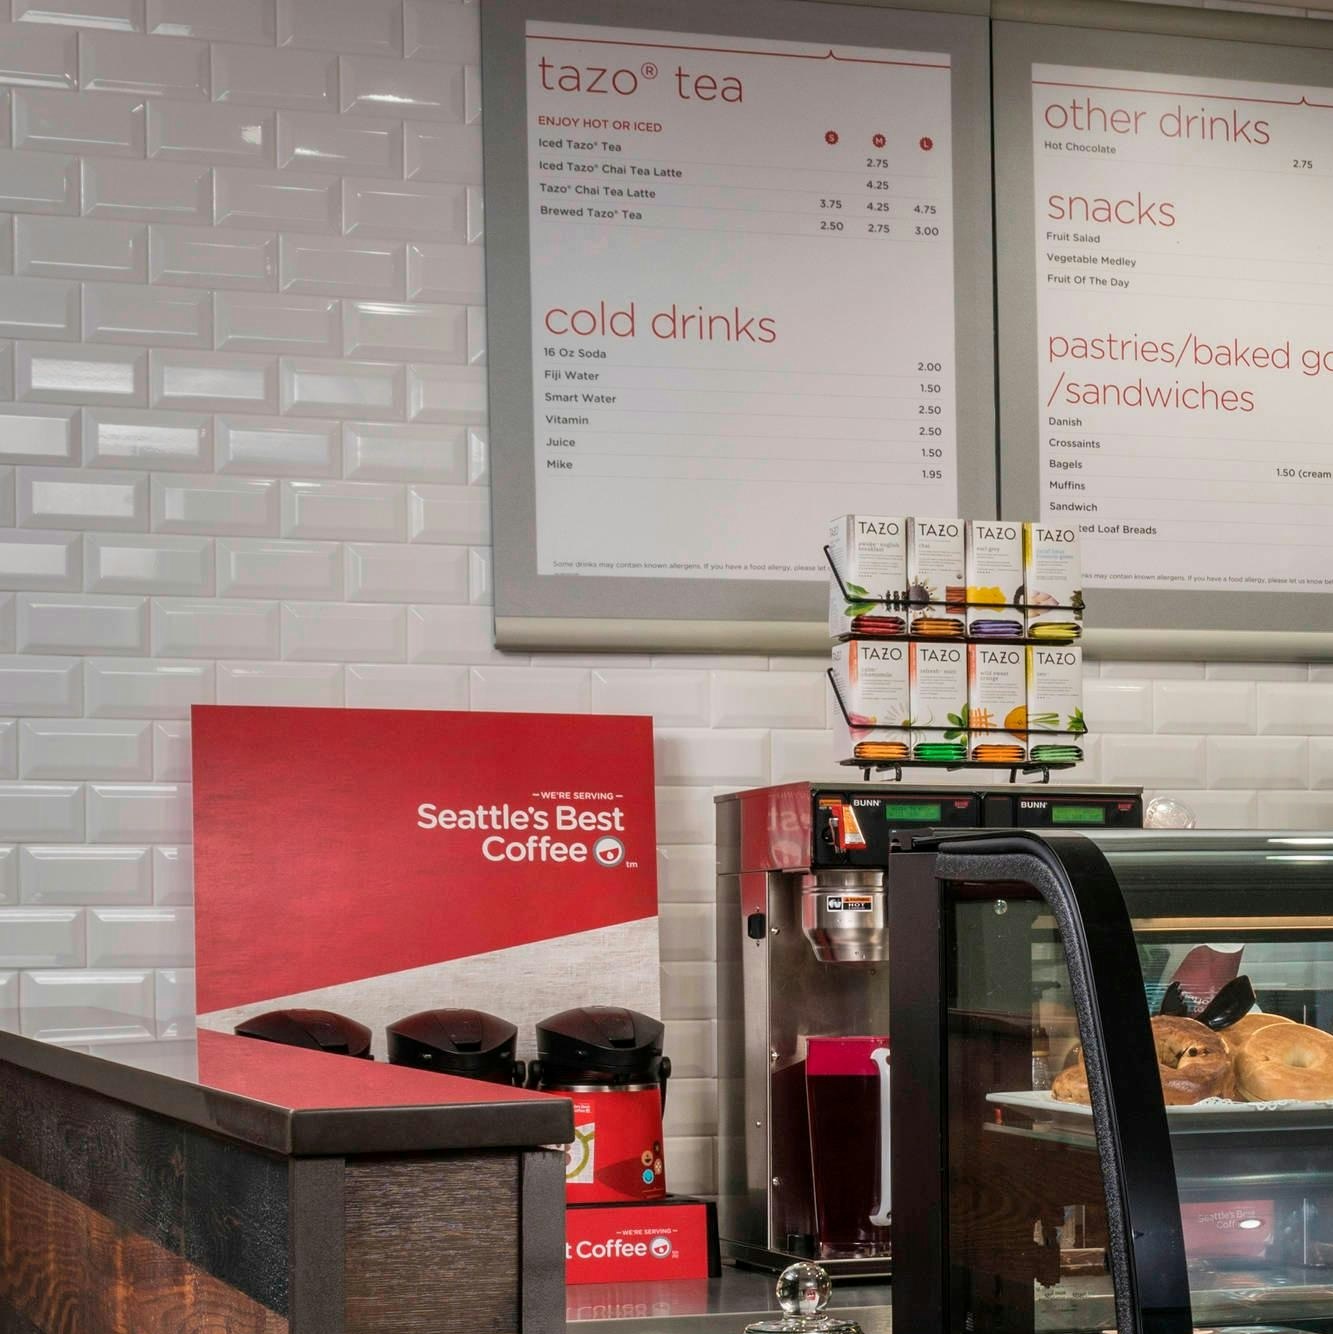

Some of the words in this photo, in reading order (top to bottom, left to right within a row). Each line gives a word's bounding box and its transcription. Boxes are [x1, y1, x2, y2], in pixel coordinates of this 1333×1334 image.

[675, 66, 742, 102] tea
[537, 115, 581, 128] ENJOY
[582, 118, 610, 129] HOT
[611, 119, 631, 131] OR
[633, 121, 663, 133] ICED
[1045, 97, 1146, 134] other
[1160, 105, 1270, 144] drinks
[538, 137, 564, 149] Iced
[600, 141, 622, 153] Tea
[1043, 140, 1063, 151] Hot
[1065, 141, 1117, 155] Chocolate
[539, 160, 564, 171] Iced
[601, 163, 627, 175] Chai
[629, 165, 651, 177] Tea
[653, 167, 683, 178] Latte
[866, 157, 889, 169] 2.75
[1292, 159, 1313, 170] 2.75
[574, 184, 600, 196] Chai
[602, 186, 624, 197] Tea
[626, 187, 657, 199] Latte
[865, 179, 889, 191] 4.25
[540, 204, 584, 217] Brewed
[621, 209, 643, 221] Tea
[819, 198, 843, 210] 3.75
[866, 201, 890, 212] 4.25
[913, 204, 937, 215] 4.75
[1048, 192, 1175, 227] snacks
[820, 220, 845, 232] 2.50
[867, 223, 891, 234] 2.75
[914, 225, 940, 237] 3.00
[1046, 231, 1071, 242] Fruit
[1072, 233, 1101, 244] Salad
[1046, 252, 1098, 265] Vegetable
[1100, 255, 1137, 268] Medley
[1047, 273, 1071, 284] Fruit
[1073, 275, 1087, 285] Of
[1088, 276, 1108, 287] The
[1110, 277, 1130, 289] Day
[545, 301, 634, 337] cold
[652, 304, 776, 343] drinks
[543, 347, 556, 357] 16
[558, 347, 575, 358] Oz
[577, 348, 607, 359] Soda
[1050, 333, 1289, 369] pastries/baked
[917, 361, 942, 373] 2.00
[544, 369, 562, 382] Fiji
[564, 370, 600, 381] Water
[920, 383, 942, 394] 1.50
[1047, 372, 1254, 412] /sandwiches
[544, 391, 579, 403] Smart
[581, 393, 617, 404] Water
[918, 404, 942, 415] 2.50
[545, 415, 589, 425] Vitamin
[1048, 416, 1083, 427] Danish
[919, 426, 943, 437] 2.50
[545, 437, 576, 448] Juice
[1048, 437, 1101, 449] Crossaints
[921, 447, 943, 458] 1.50
[546, 459, 574, 470] Mike
[1049, 458, 1083, 471] Bagels
[921, 469, 943, 480] 1.95
[1276, 467, 1296, 478] 1.50
[1297, 469, 1332, 479] (cream
[1049, 480, 1086, 491] Muffins
[1049, 501, 1098, 512] Sandwich
[857, 521, 900, 536] TAZO
[917, 523, 959, 538] TAZO
[975, 526, 1017, 541] TAZO
[1035, 528, 1075, 543] TAZO
[1097, 524, 1120, 534] Loaf
[1122, 524, 1158, 535] Breads
[860, 646, 903, 661] TAZO
[919, 648, 961, 663] TAZO
[979, 650, 1020, 665] TAZO
[1036, 651, 1077, 666] TAZO
[573, 792, 613, 800] SERVING
[556, 805, 624, 831] Best
[482, 836, 588, 862] Coffee
[577, 1240, 647, 1258] Coffee
